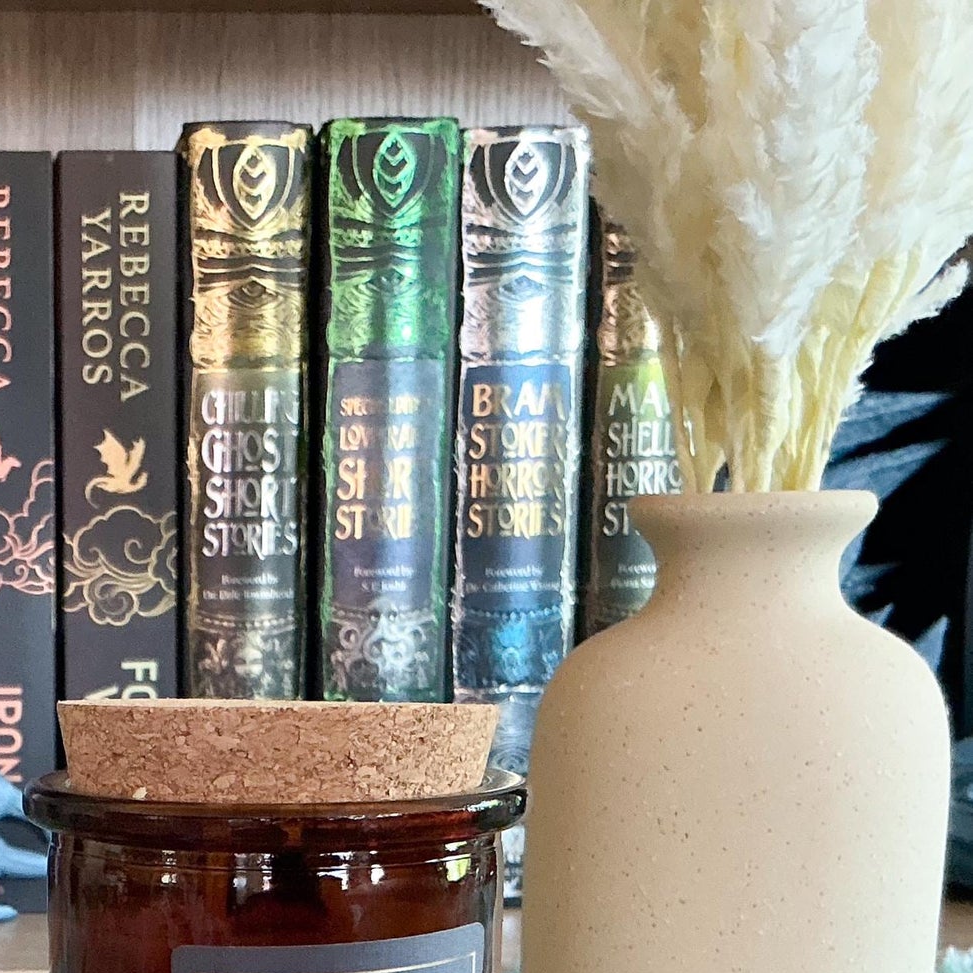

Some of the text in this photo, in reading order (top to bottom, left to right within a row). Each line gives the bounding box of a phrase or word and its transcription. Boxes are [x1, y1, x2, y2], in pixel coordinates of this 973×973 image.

[81, 206, 114, 385] YARROS
[119, 190, 151, 403] REBECCA
[608, 381, 671, 417] MA
[201, 427, 298, 474] GHOST
[606, 420, 677, 458] SHELL
[203, 475, 297, 522] SHORT
[605, 459, 683, 497] HORRO
[202, 520, 298, 560] STORIES
